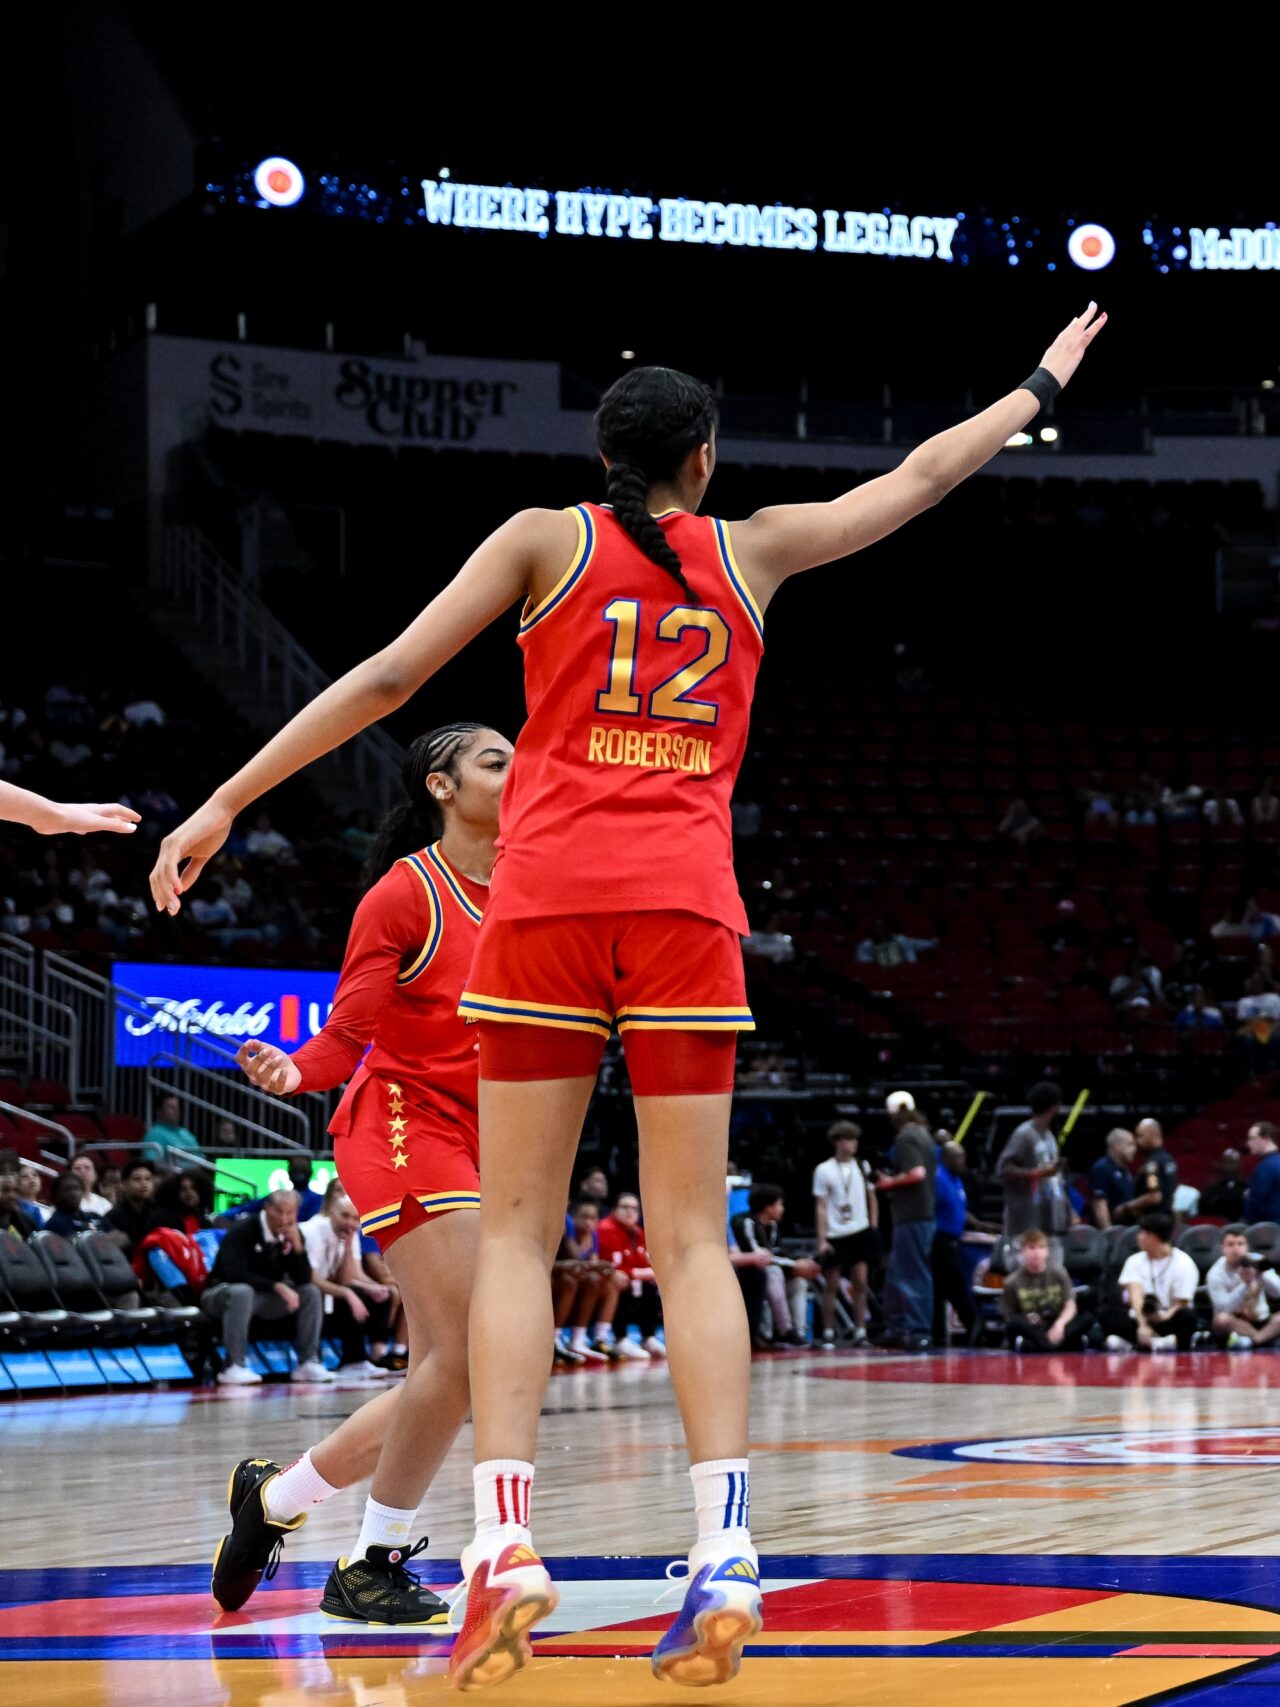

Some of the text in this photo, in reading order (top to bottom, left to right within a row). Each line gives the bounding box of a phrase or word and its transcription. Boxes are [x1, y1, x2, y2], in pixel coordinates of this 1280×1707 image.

[421, 179, 959, 260] WHERE HYPE BECOMES LEGACY
[335, 358, 517, 415] Supper
[367, 398, 477, 441] Club
[594, 597, 731, 726] 12
[587, 726, 713, 774] ROBERSON
